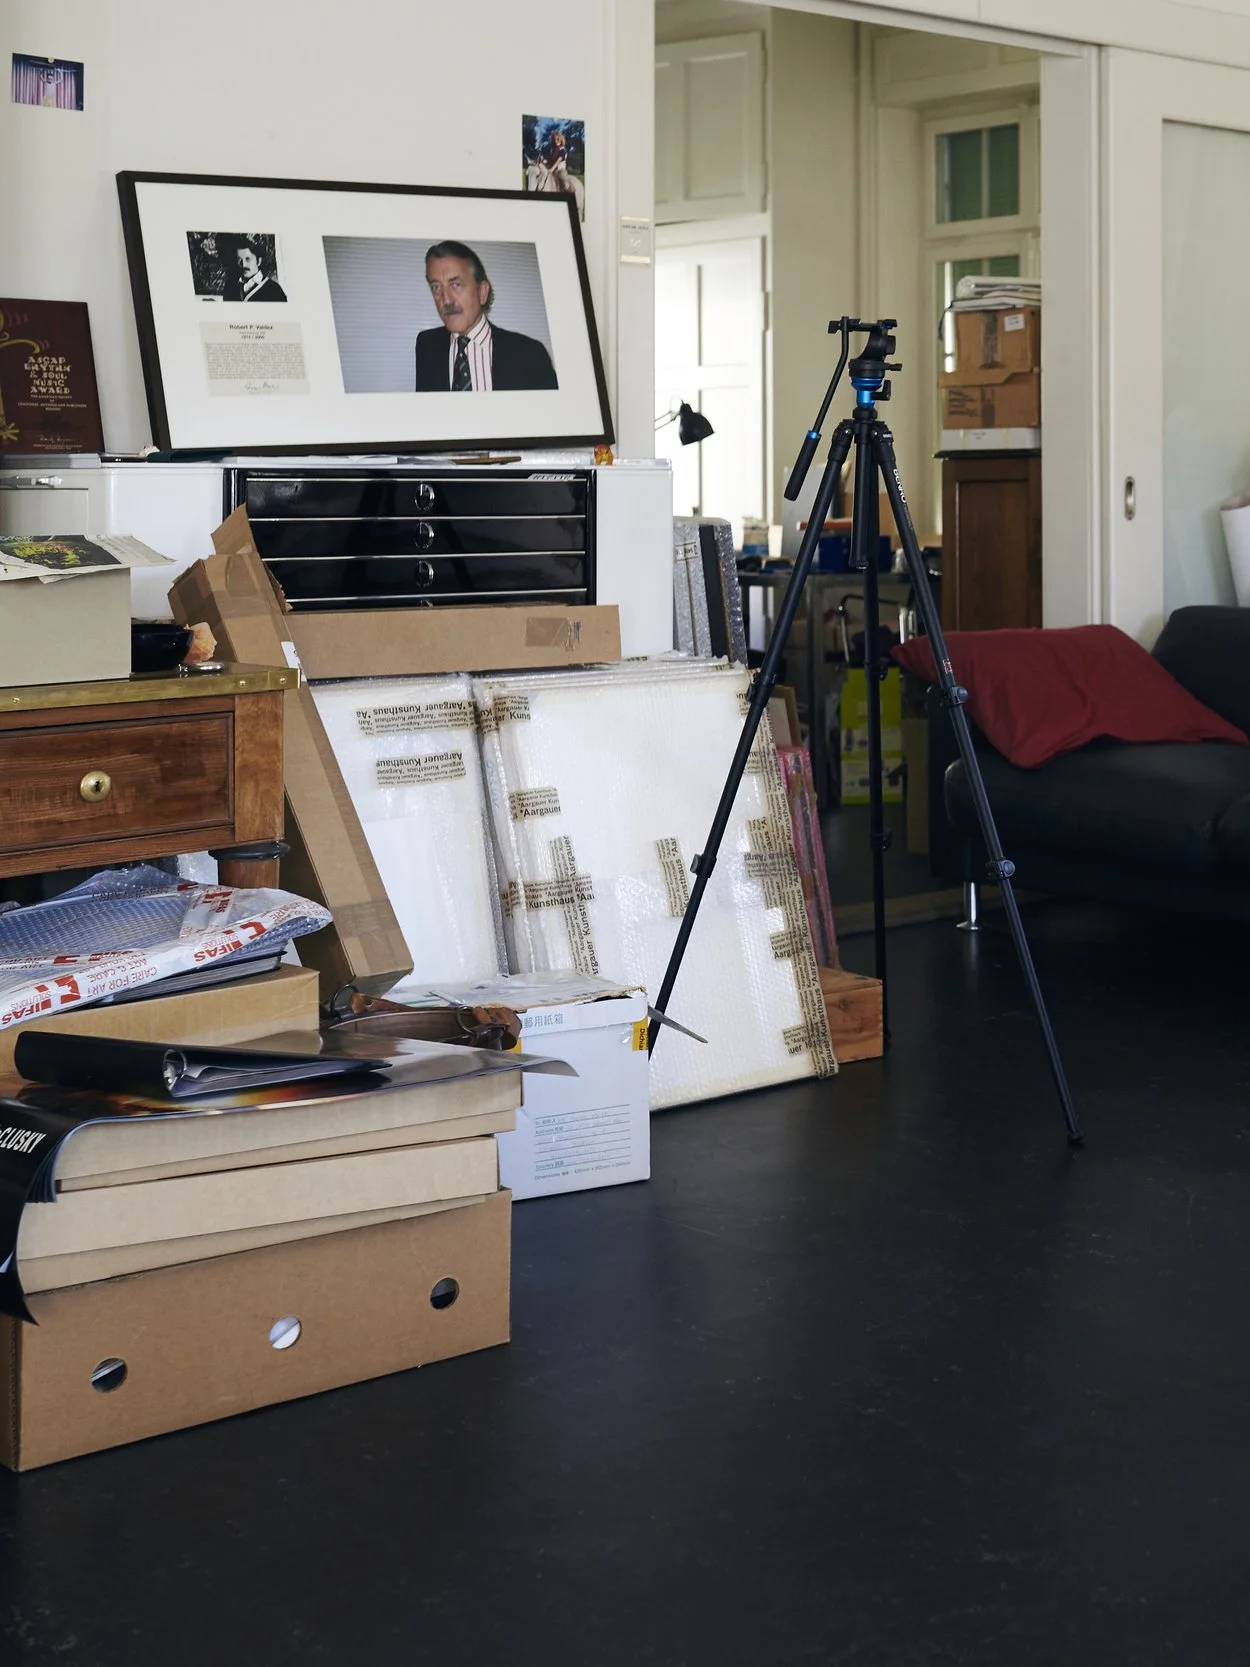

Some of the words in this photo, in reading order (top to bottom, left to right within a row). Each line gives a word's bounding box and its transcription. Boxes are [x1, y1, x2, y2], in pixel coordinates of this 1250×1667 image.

[28, 356, 66, 364] ASCAP
[24, 364, 71, 372] RHYTHM
[33, 379, 65, 387] MUSIC
[373, 704, 421, 715] Kunsthaus
[375, 758, 421, 768] Kunsthaus
[424, 752, 462, 764] Aargauer
[781, 793, 791, 840] Kunsthaus
[528, 896, 576, 909] Kunsthaus
[797, 890, 808, 937] Kunsthaus
[131, 967, 158, 984] CARE
[87, 982, 107, 998] ART
[109, 975, 130, 991] FOR
[815, 988, 828, 1037] Kunsthaus
[0, 1127, 46, 1153] CLUSKY
